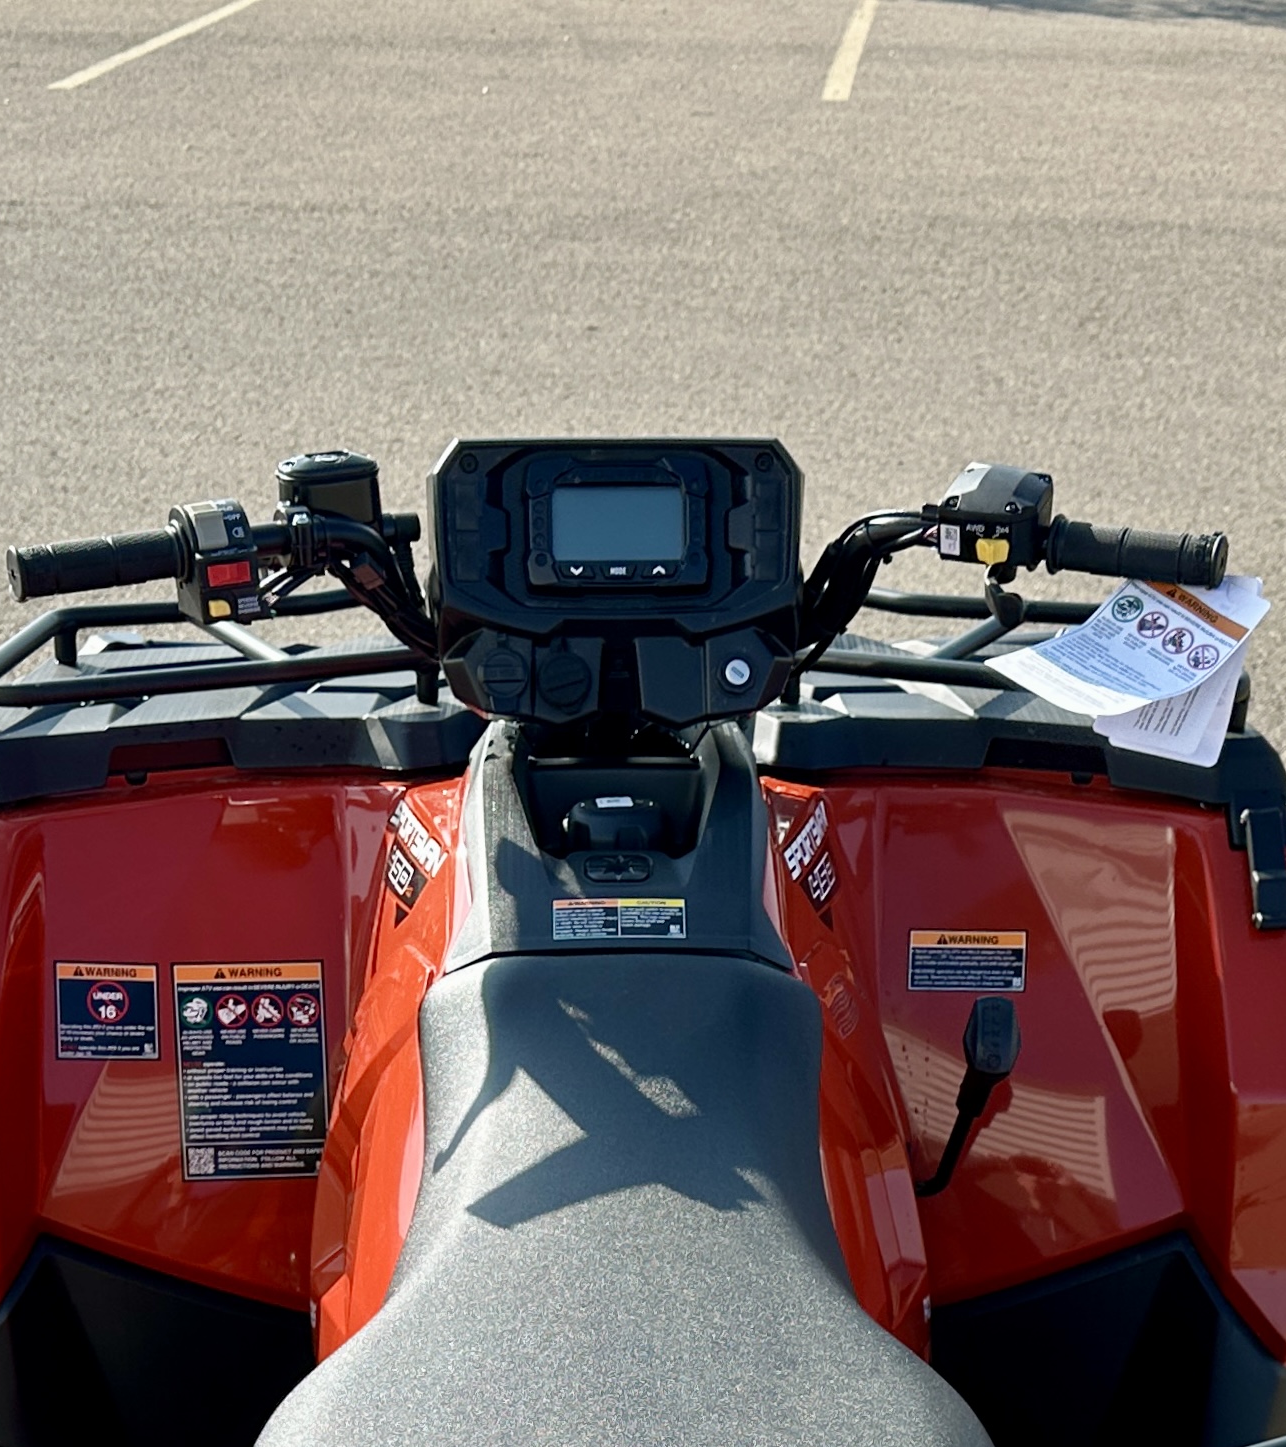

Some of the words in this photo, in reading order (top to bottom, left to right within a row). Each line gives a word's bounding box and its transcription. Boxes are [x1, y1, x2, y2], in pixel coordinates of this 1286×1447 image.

[610, 566, 627, 576] MODE
[1177, 593, 1218, 625] WARNING
[948, 935, 999, 945] WARNING
[85, 967, 137, 978] WARNING
[229, 968, 282, 979] WARNING
[93, 991, 123, 1001] UNDER
[98, 1005, 117, 1019] 16
